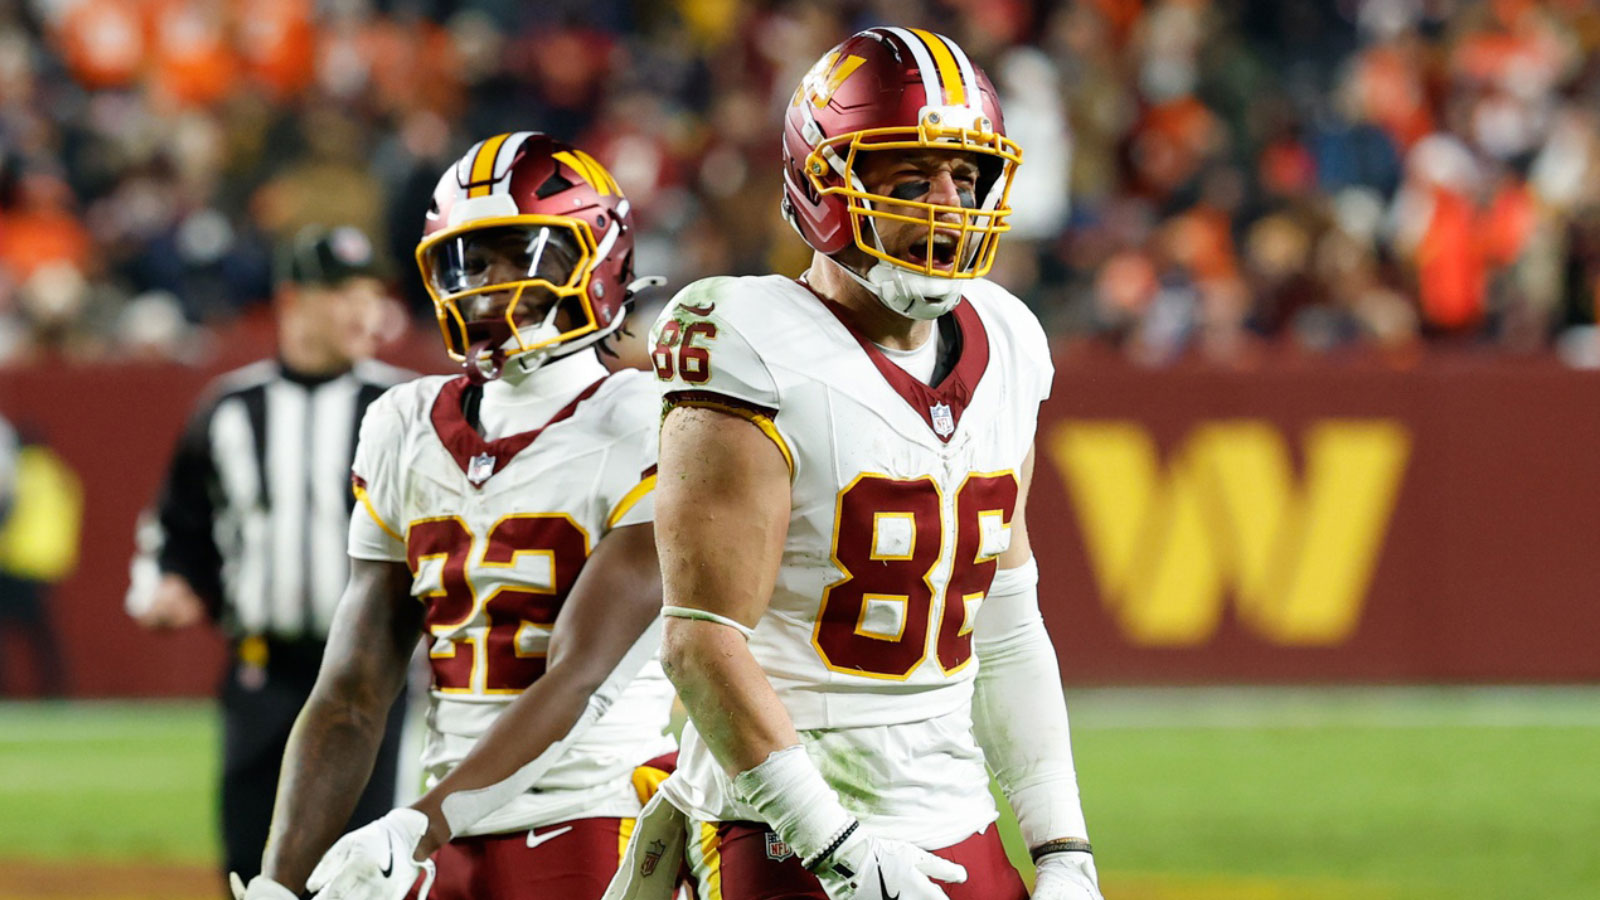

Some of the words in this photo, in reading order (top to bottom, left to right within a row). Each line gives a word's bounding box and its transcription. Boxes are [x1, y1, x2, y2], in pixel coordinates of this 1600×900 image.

[652, 319, 718, 386] 86
[405, 512, 590, 695] 22
[811, 468, 1019, 681] 86
[1048, 419, 1411, 644] W
[771, 843, 790, 856] NFL
